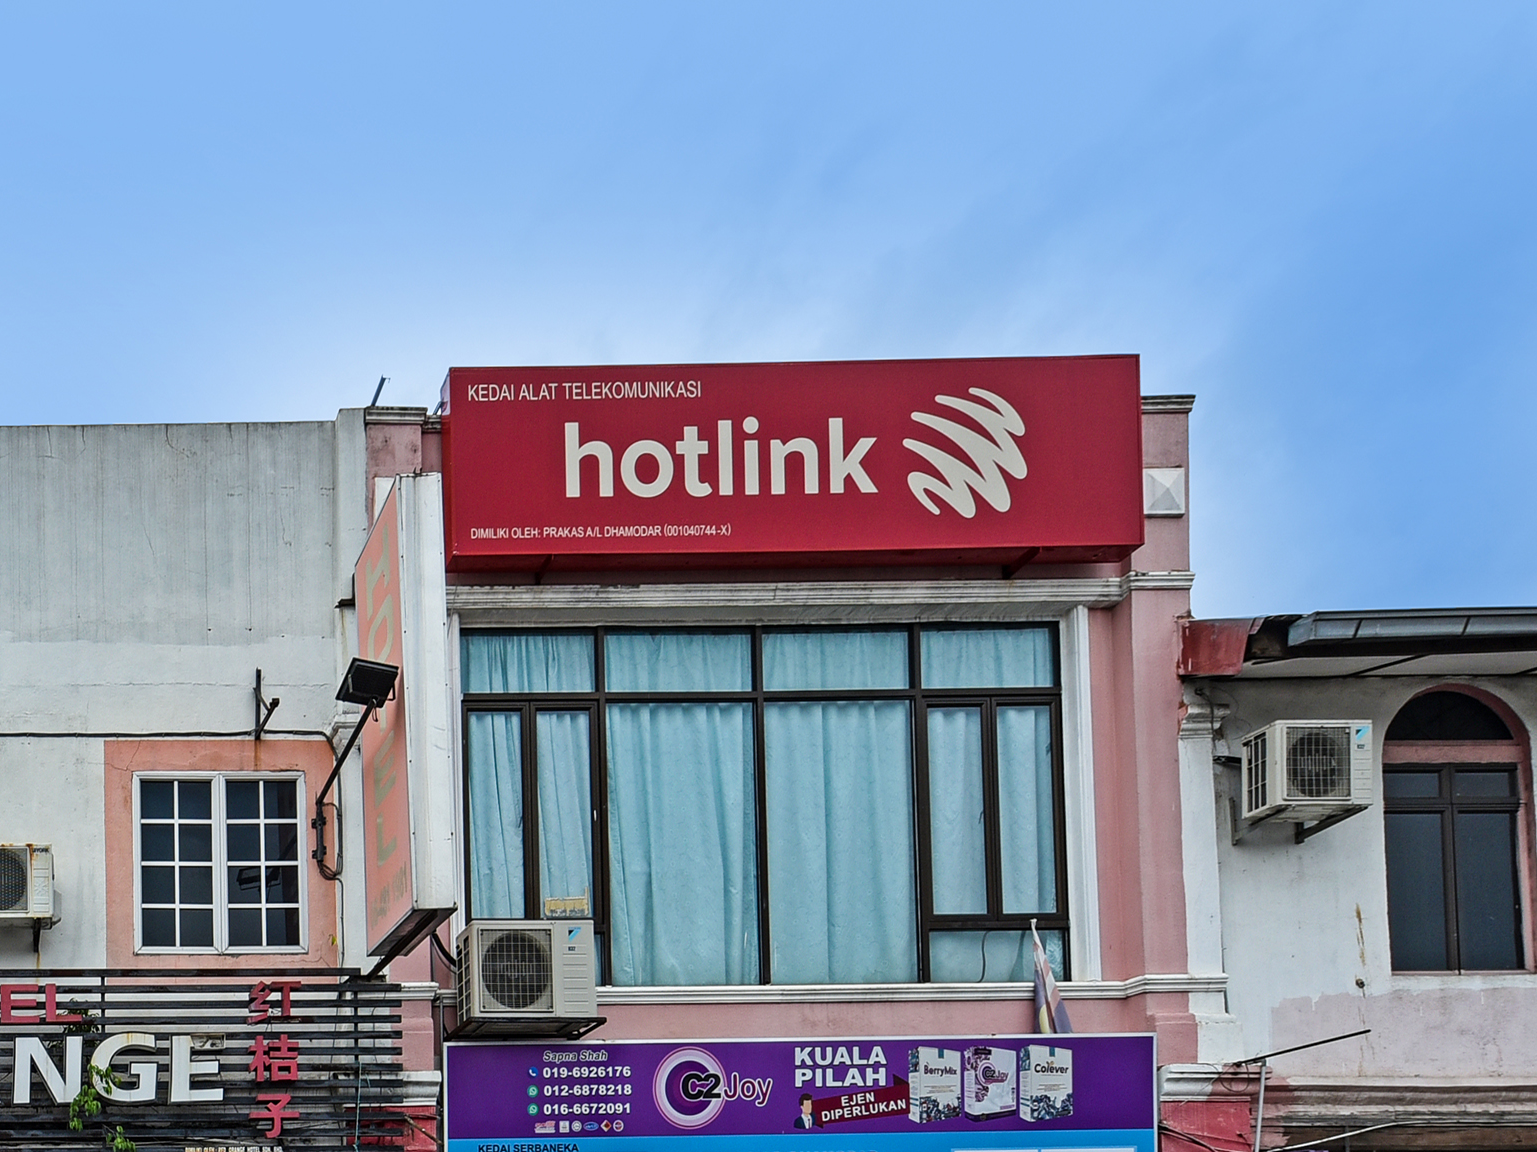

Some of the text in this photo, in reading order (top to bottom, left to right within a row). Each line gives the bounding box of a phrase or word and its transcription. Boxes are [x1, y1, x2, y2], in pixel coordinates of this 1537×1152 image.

[468, 381, 701, 401] KEDAI ALAT TELEKOMUNIKASI
[563, 416, 879, 498] hotlink
[471, 523, 731, 539] DIMILIKI OLEH: PRAKAS A/L DHAMODAR (001040744-X)
[247, 980, 301, 1139] 红桔子
[543, 1049, 608, 1064] Sapna Shah
[794, 1046, 887, 1066] KUALA
[543, 1066, 632, 1079] 019-6926176
[795, 1068, 886, 1088] PILAH
[544, 1084, 632, 1097] 012-6878218
[841, 1092, 875, 1107] EJEN
[543, 1103, 631, 1115] 016-6672091
[822, 1099, 906, 1122] DIPERLUKAN
